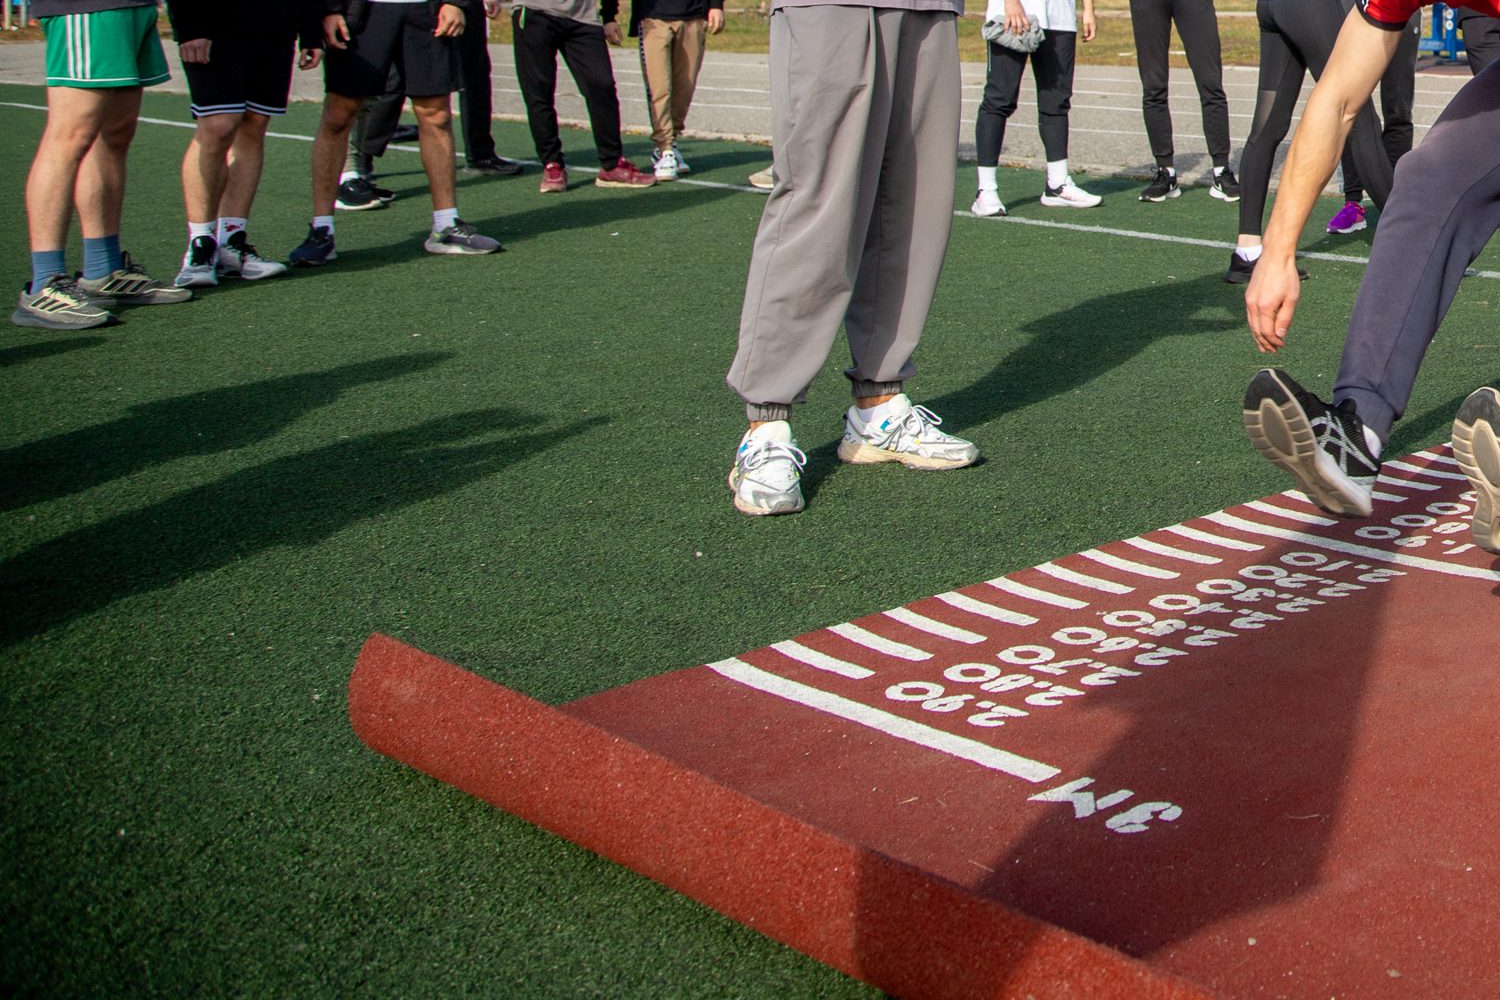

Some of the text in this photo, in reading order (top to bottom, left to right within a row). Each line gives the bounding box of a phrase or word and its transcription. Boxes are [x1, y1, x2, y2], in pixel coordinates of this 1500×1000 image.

[1354, 526, 1476, 554] 1.90
[1238, 565, 1367, 597] 2.20
[1280, 552, 1407, 583] 2.10
[1148, 594, 1285, 629] 2.40
[1196, 579, 1326, 613] 2.30
[1102, 610, 1238, 646] 2.50
[1051, 626, 1189, 666] 2.60
[996, 645, 1142, 686] 2.70
[943, 663, 1085, 706] 2.80
[885, 681, 1029, 727] 2.90
